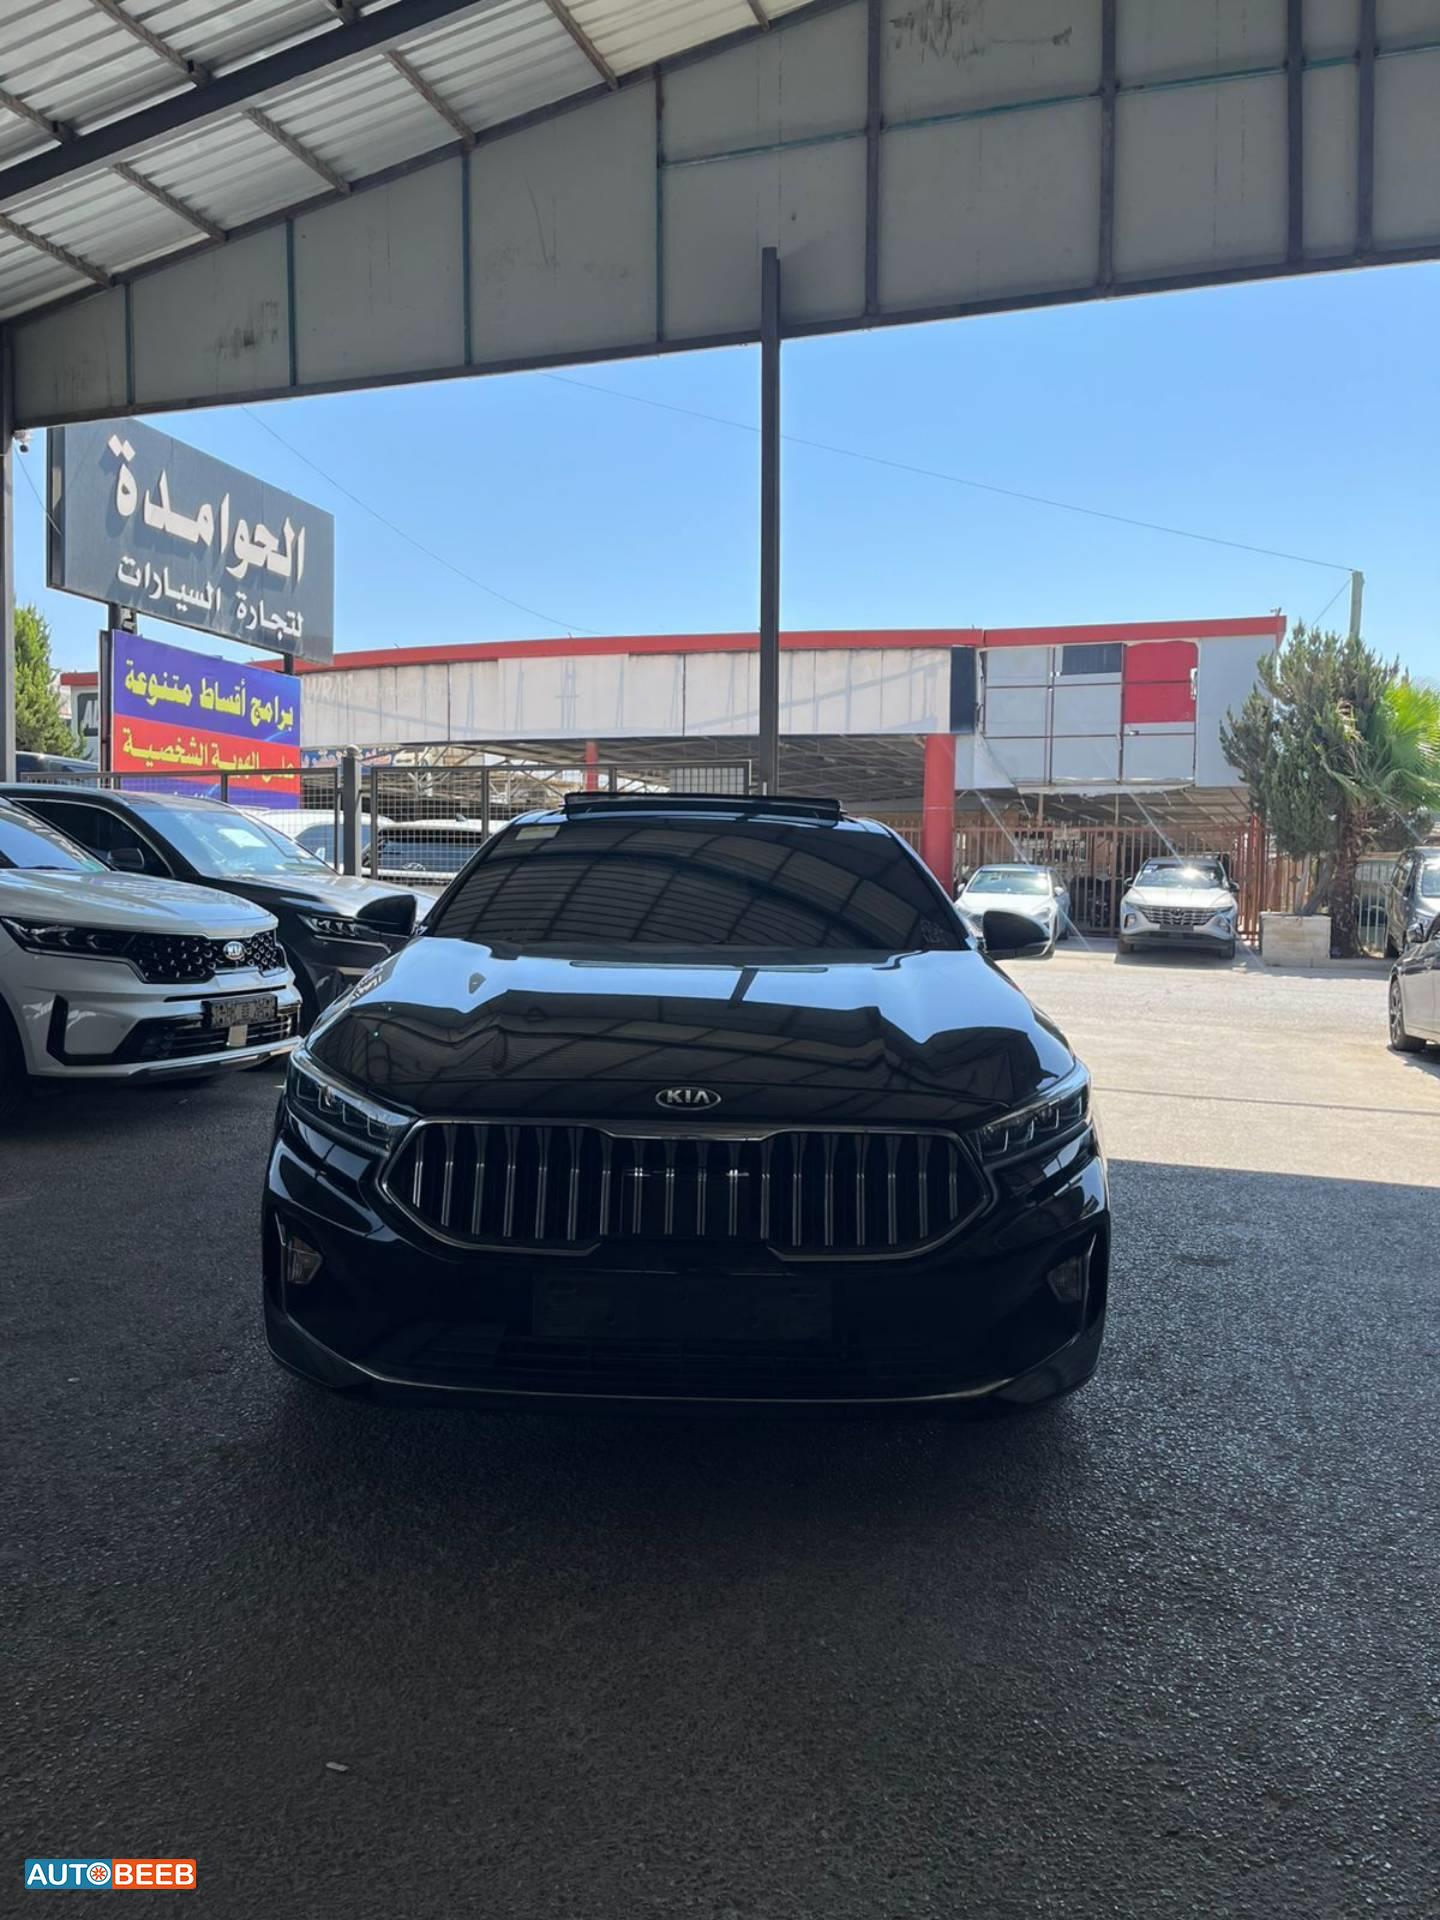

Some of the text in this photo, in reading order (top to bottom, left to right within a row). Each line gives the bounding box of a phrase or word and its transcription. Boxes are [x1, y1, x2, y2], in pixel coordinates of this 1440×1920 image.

[108, 434, 306, 583] الحوامدة
[118, 556, 303, 640] لتجارة السيارات
[124, 659, 294, 732] برامج أقساط متنوعة
[122, 727, 208, 767] الشخصية
[667, 1089, 710, 1104] KIA
